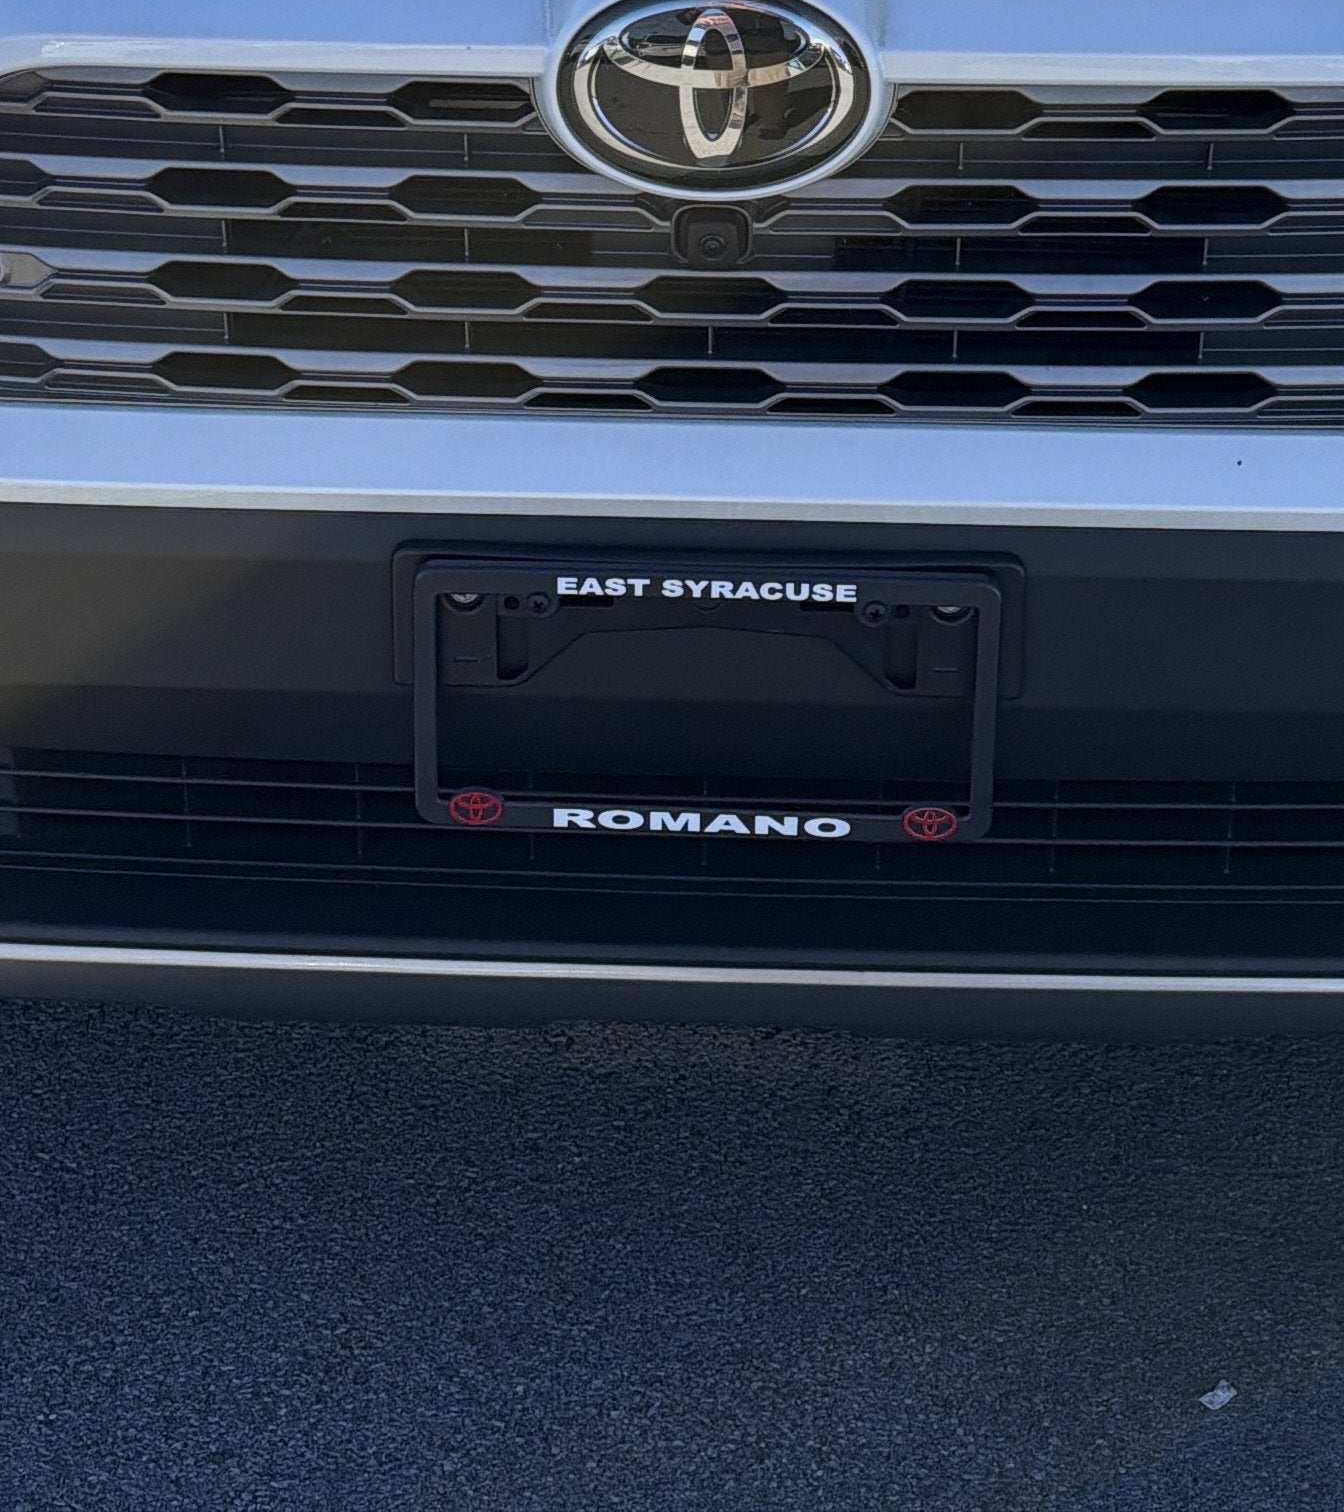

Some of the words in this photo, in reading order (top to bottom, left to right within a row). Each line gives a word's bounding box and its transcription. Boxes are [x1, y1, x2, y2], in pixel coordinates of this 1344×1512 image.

[556, 576, 651, 596] EAST
[661, 579, 858, 603] SYRACUSE
[552, 808, 851, 838] ROMANO
